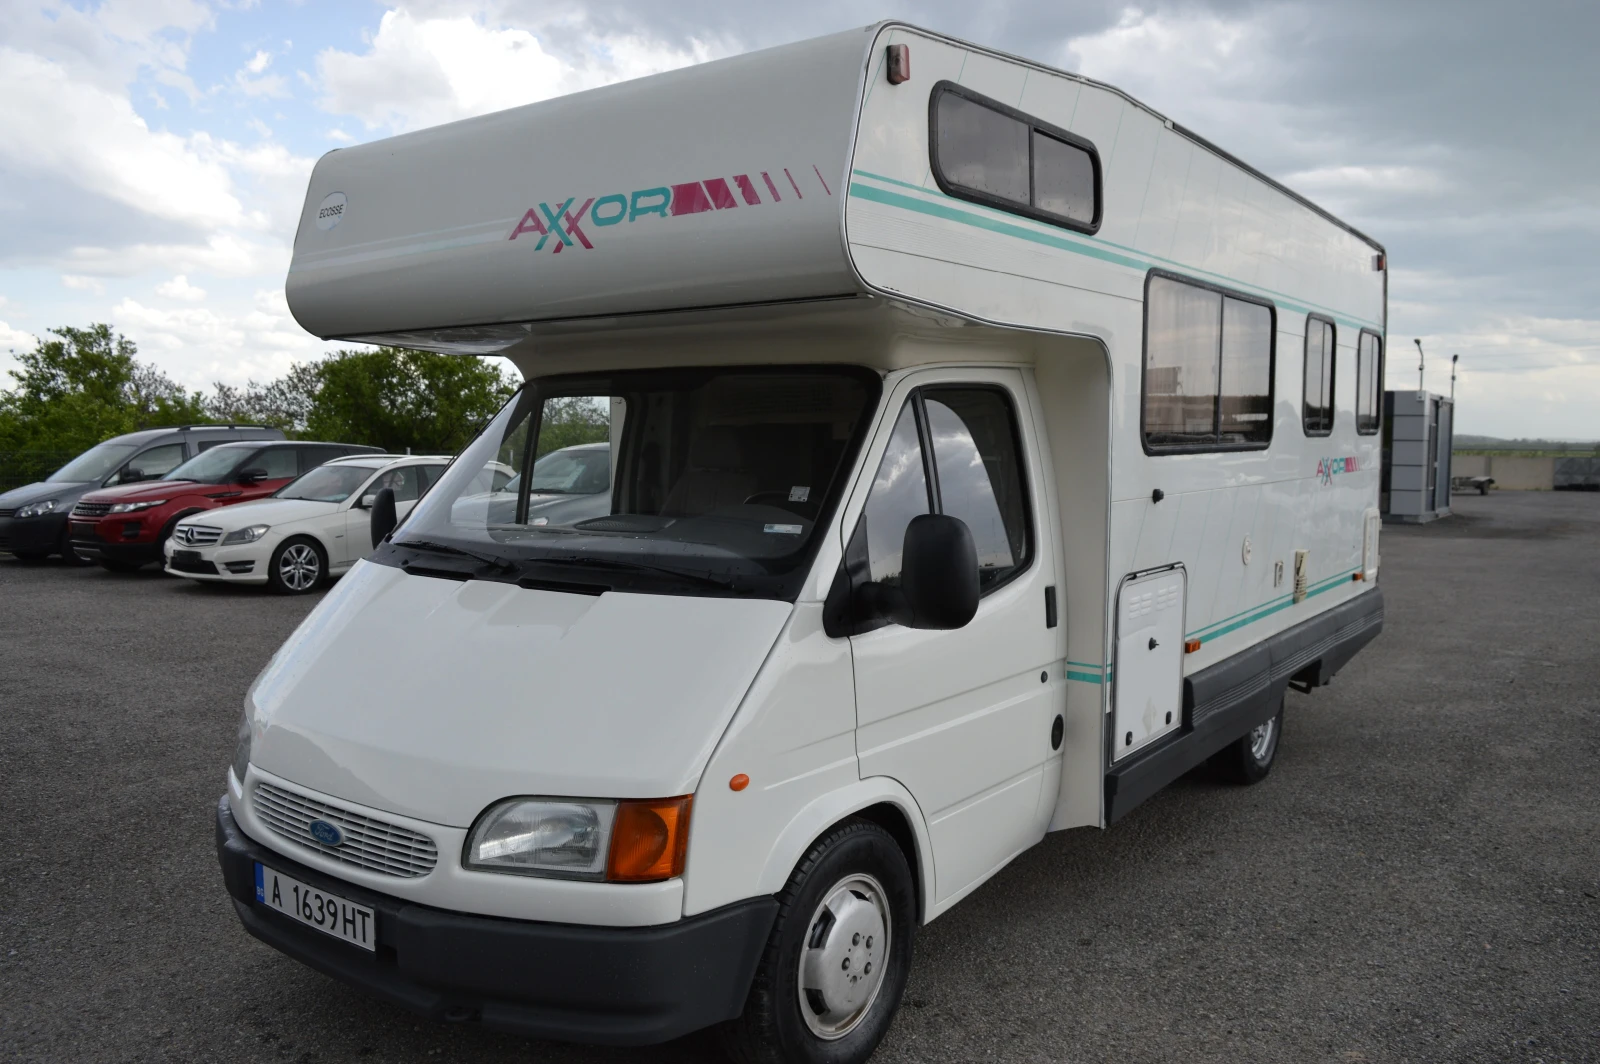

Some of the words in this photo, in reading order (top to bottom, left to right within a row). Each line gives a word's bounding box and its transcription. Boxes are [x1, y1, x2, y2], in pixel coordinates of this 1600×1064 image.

[509, 186, 671, 254] AXXOR
[314, 823, 335, 841] Ford
[256, 886, 265, 897] BG
